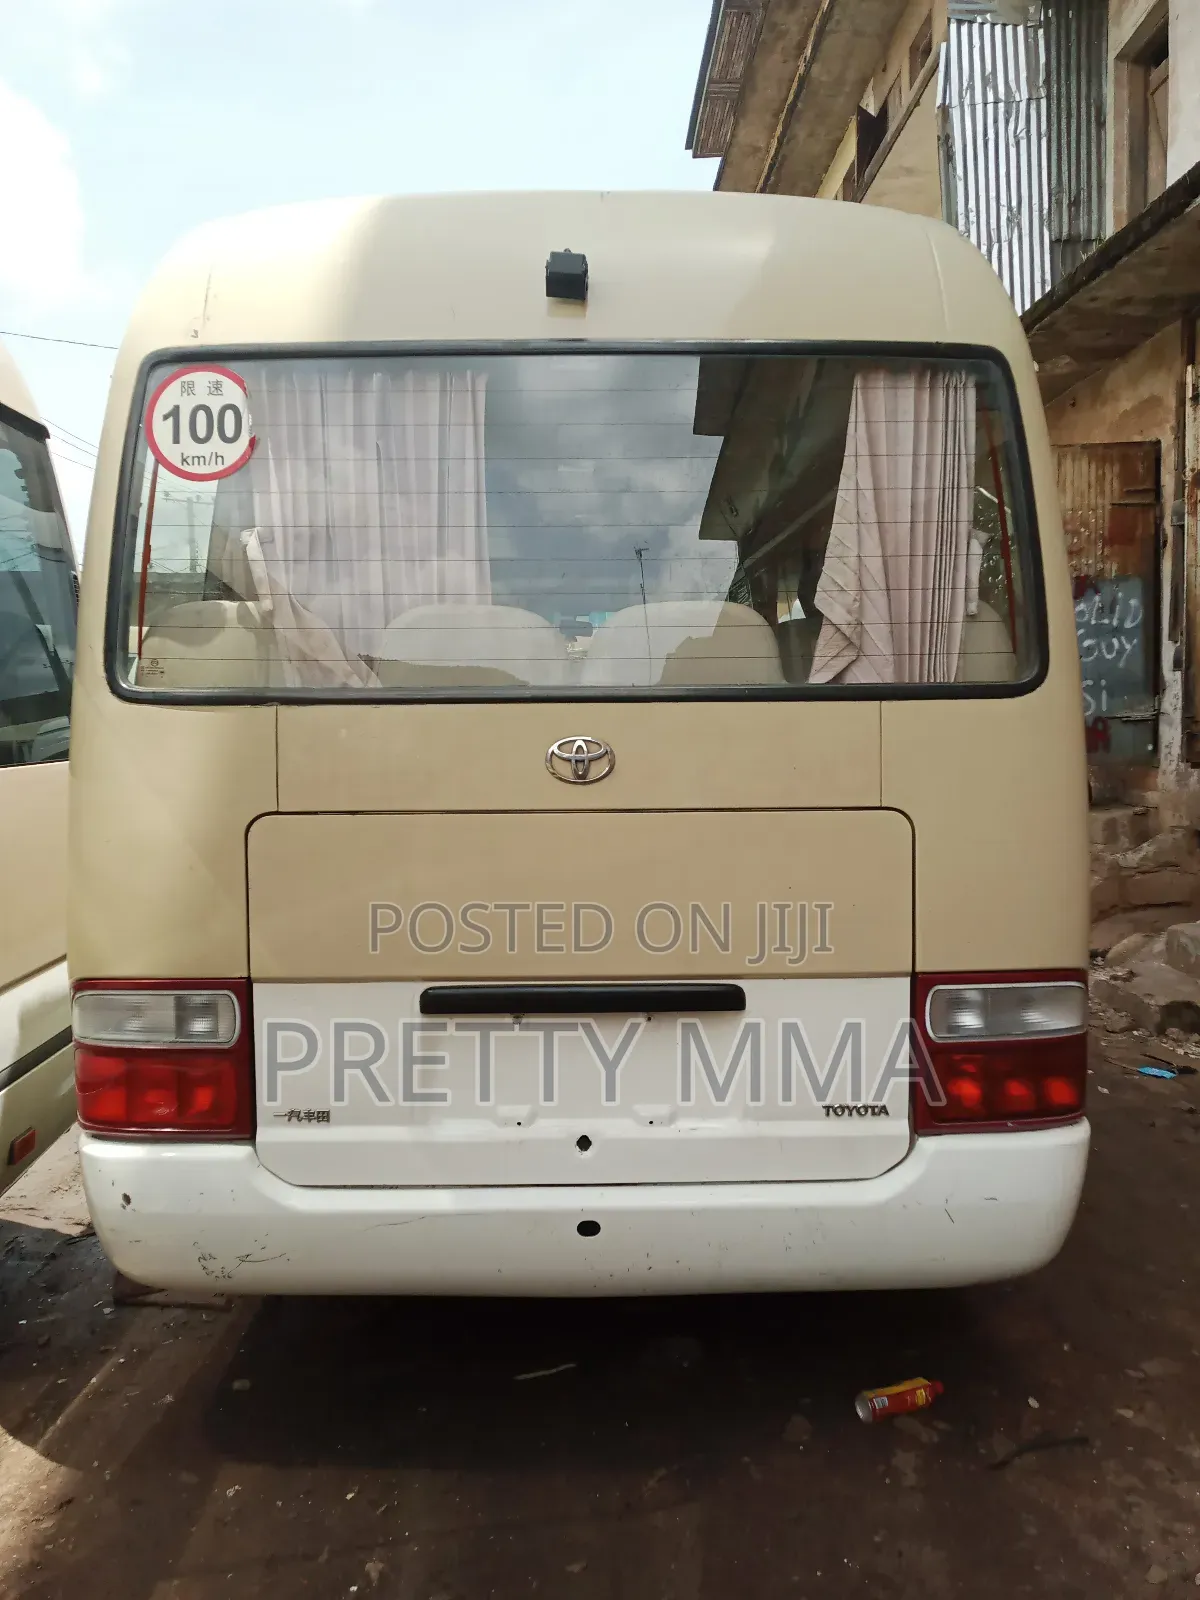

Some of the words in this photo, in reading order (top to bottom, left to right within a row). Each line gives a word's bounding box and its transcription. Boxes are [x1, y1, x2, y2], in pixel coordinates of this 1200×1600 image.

[180, 379, 224, 397] 限速
[162, 403, 243, 445] 100
[181, 452, 225, 466] km/h
[822, 1104, 890, 1117] TOYOTA
